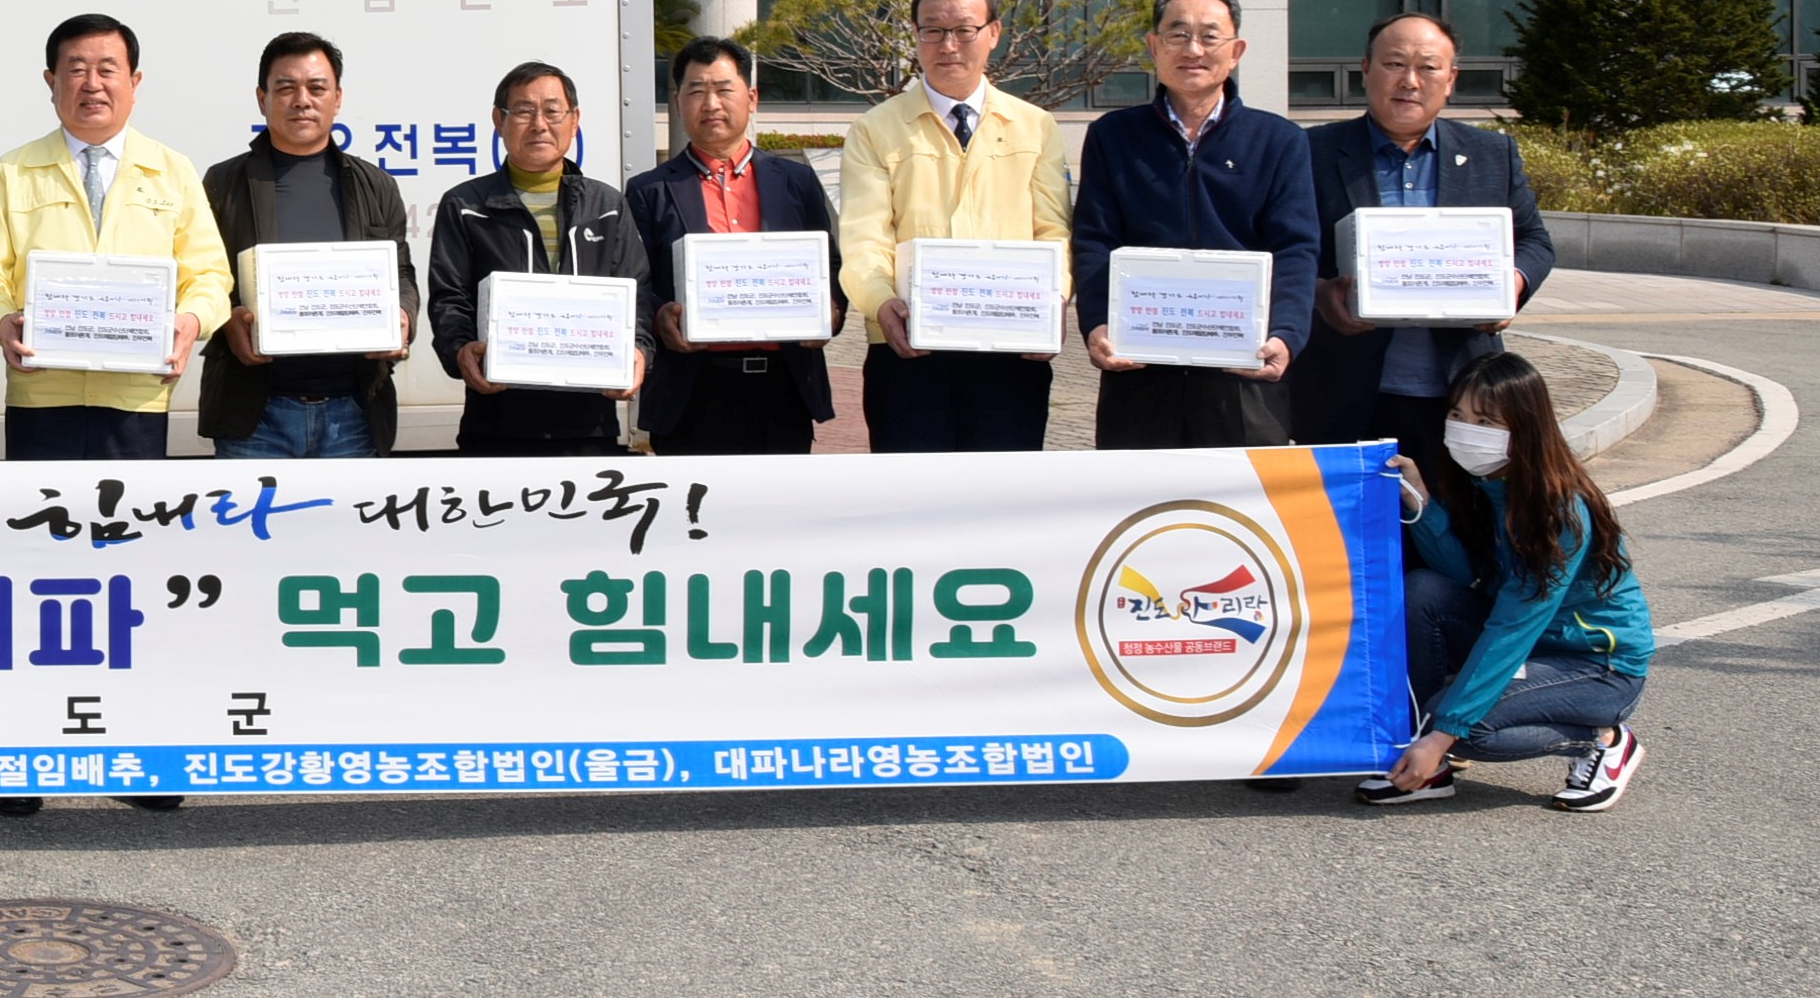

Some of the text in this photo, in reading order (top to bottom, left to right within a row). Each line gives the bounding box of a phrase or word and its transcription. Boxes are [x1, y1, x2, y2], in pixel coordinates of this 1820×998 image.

[7, 476, 335, 549] 힘내라
[352, 469, 709, 555] 대한민국!
[277, 572, 507, 667] 먹고
[560, 566, 1038, 665] 힘내세요
[1144, 642, 1183, 654] 농수산물
[1185, 640, 1232, 653] 공동브랜드
[183, 748, 690, 785] 진도강황영농조합법인(울금),
[713, 740, 1096, 780] 대파나라영농조합법인
